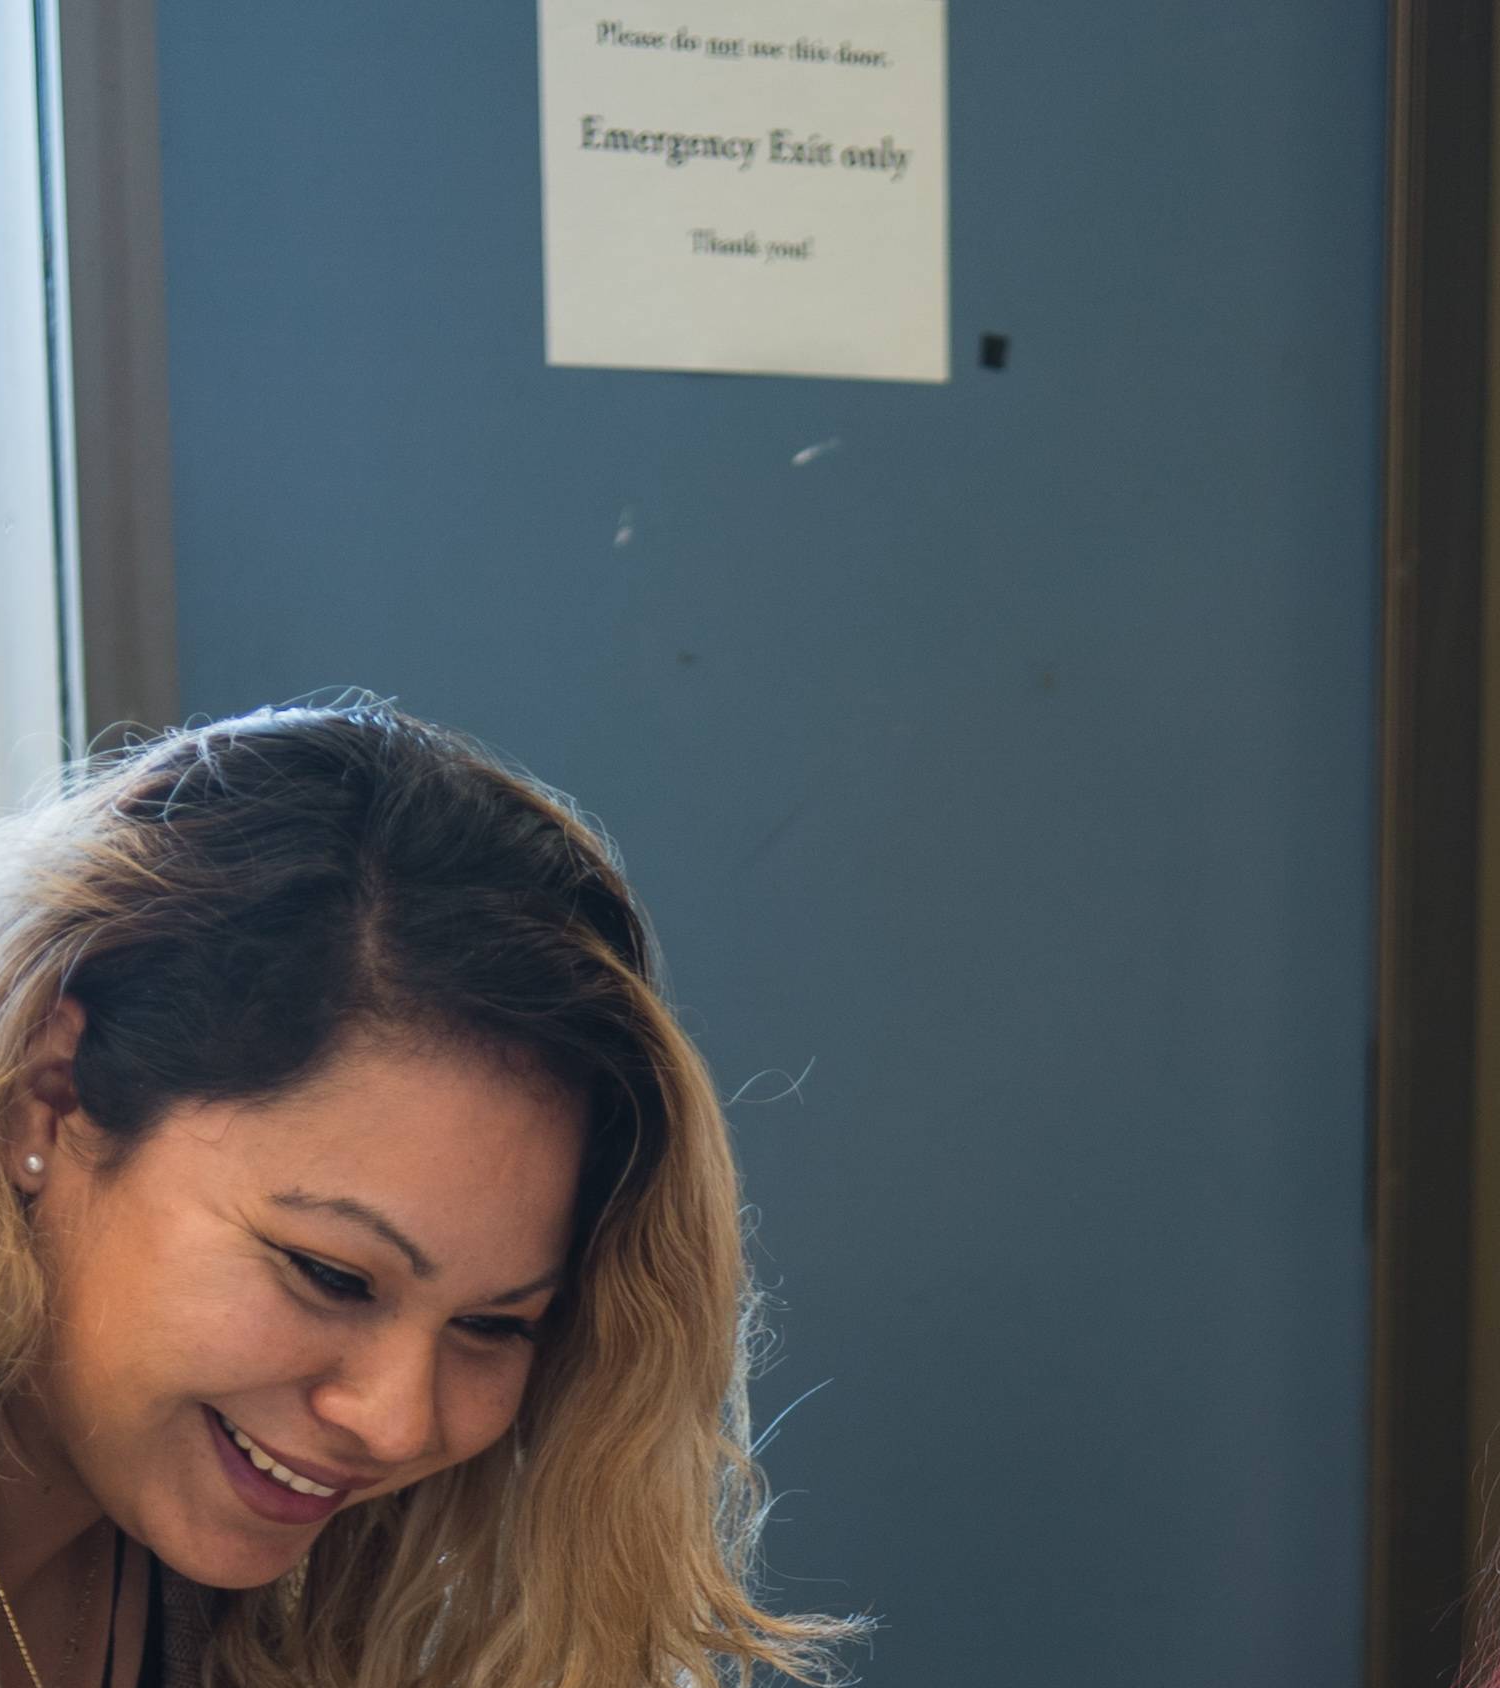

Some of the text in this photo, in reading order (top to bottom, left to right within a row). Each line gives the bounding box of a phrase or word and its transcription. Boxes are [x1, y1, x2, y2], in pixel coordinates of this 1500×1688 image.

[596, 19, 665, 48] Please
[670, 26, 697, 51] do
[706, 35, 744, 60] not
[579, 113, 909, 182] Emergency Exit only
[689, 228, 758, 259] Thank
